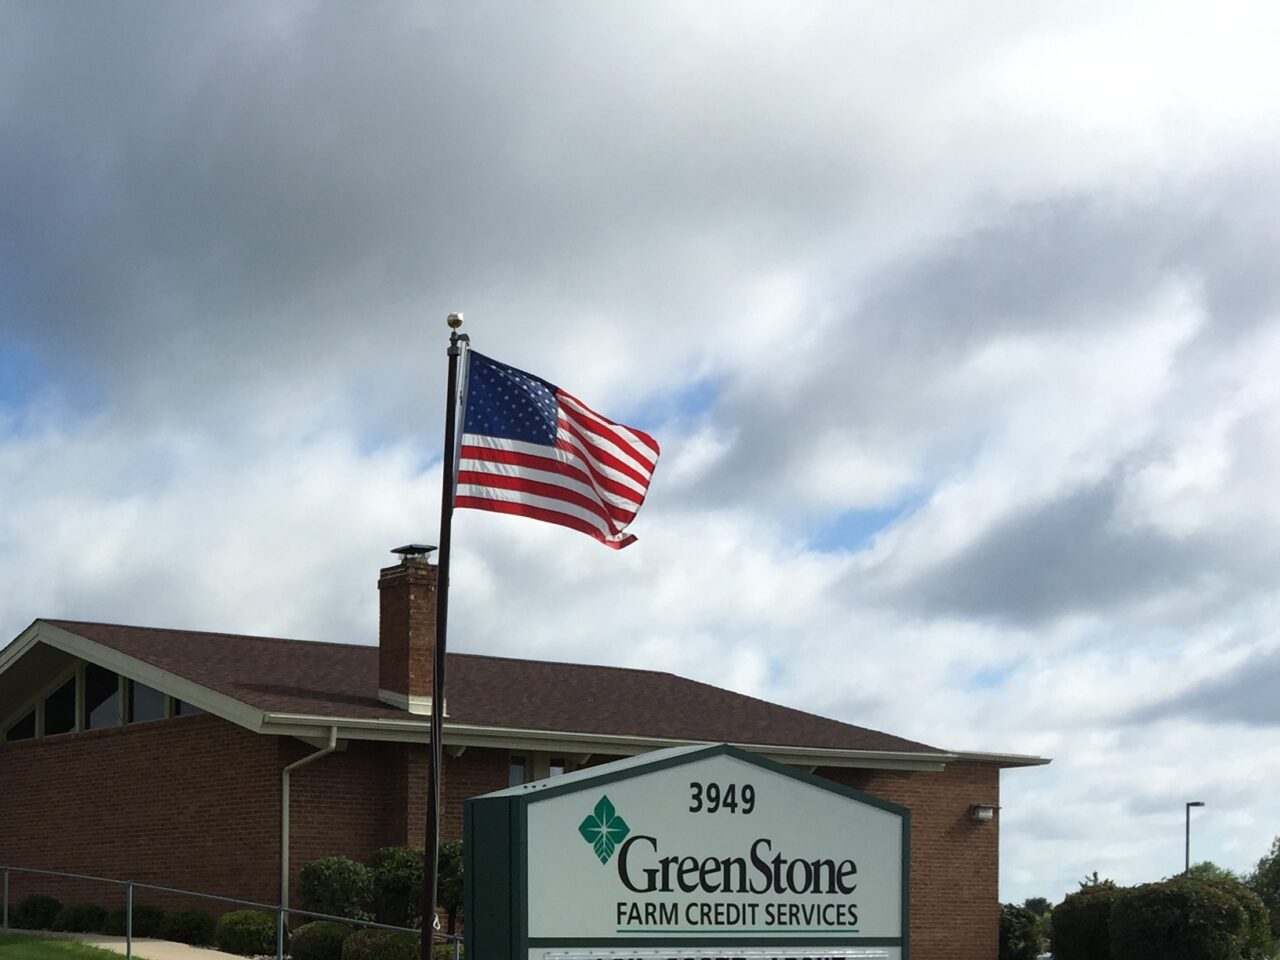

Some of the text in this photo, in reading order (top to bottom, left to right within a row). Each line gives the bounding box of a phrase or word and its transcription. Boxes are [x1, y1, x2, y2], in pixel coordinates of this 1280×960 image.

[688, 782, 756, 814] 3949
[617, 835, 857, 895] GreenStone
[616, 902, 858, 926] FARM CREDIT SERVICES
